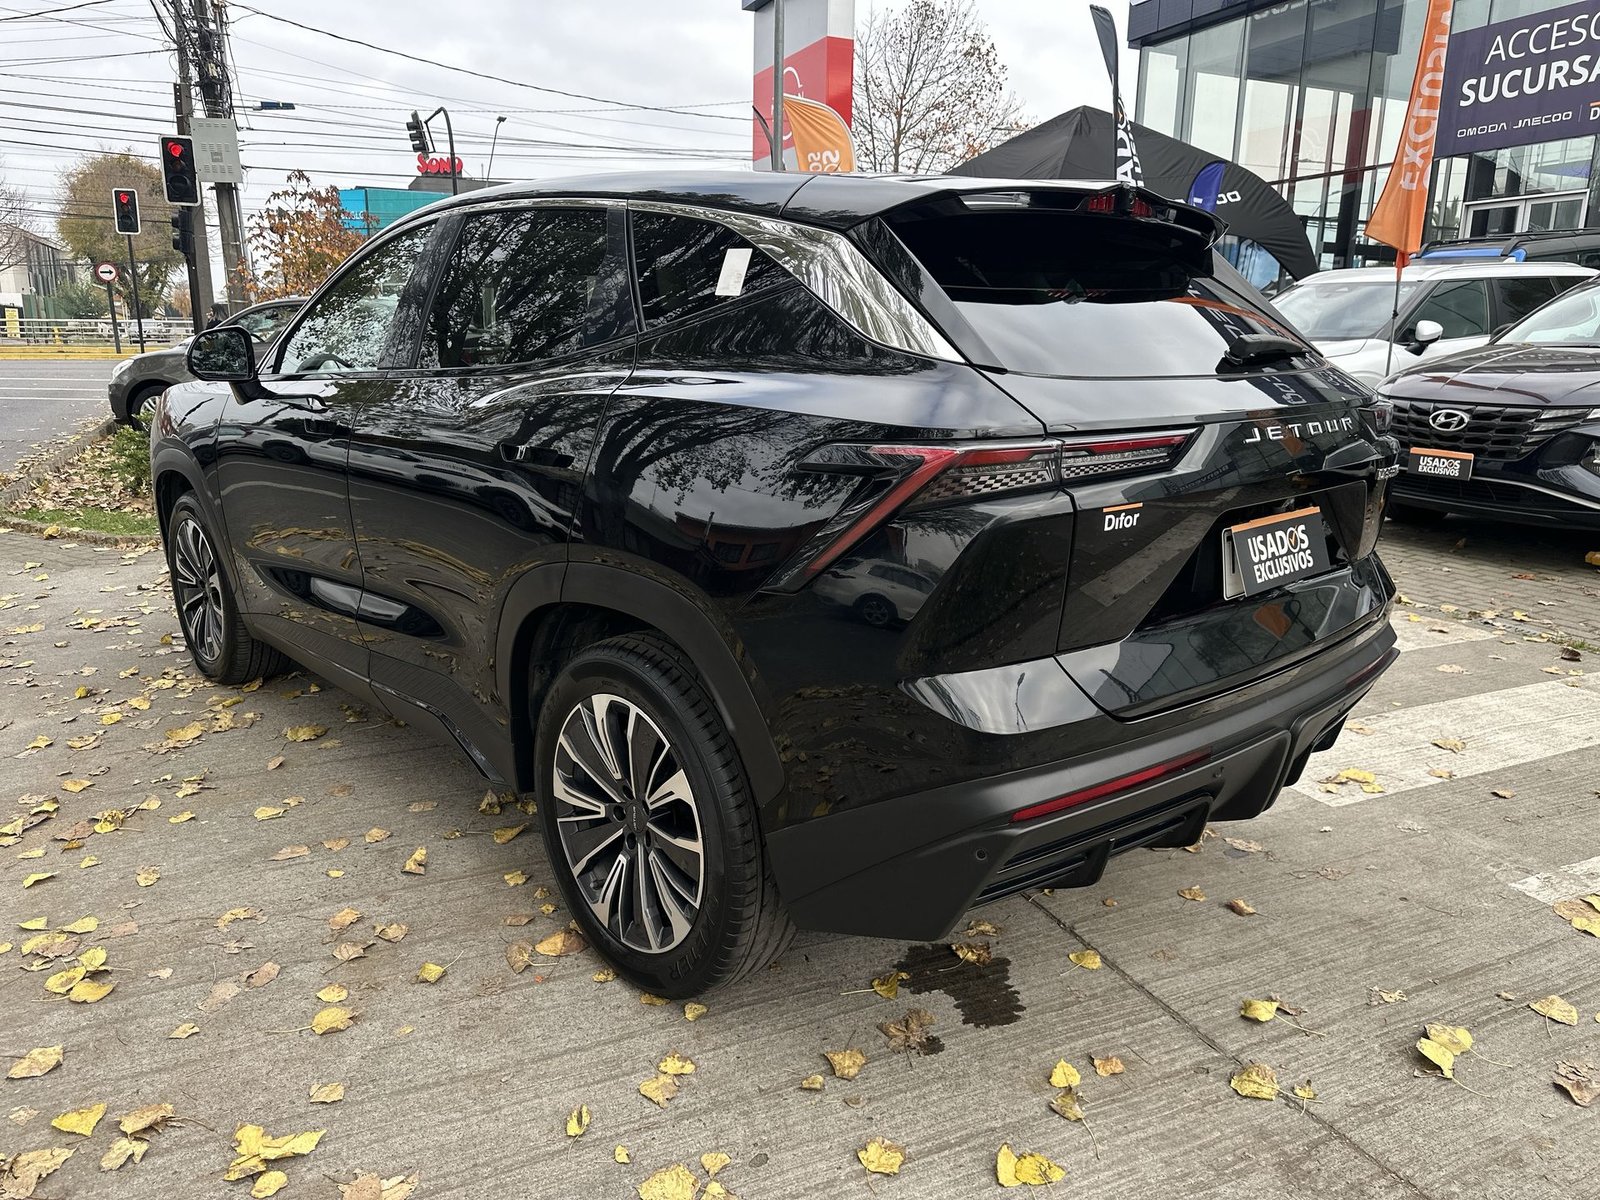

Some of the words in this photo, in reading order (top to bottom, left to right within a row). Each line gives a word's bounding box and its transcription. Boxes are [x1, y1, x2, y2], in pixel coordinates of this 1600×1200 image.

[1457, 122, 1507, 138] OMODA
[1513, 111, 1573, 129] JAECOO
[1243, 417, 1353, 444] JETOUR
[1417, 464, 1459, 477] EXCLUSIVOS
[1419, 456, 1460, 470] USADOS
[1103, 512, 1140, 532] Difor
[1247, 524, 1309, 563] USADOS
[1253, 549, 1314, 584] EXCLUSIVOS
